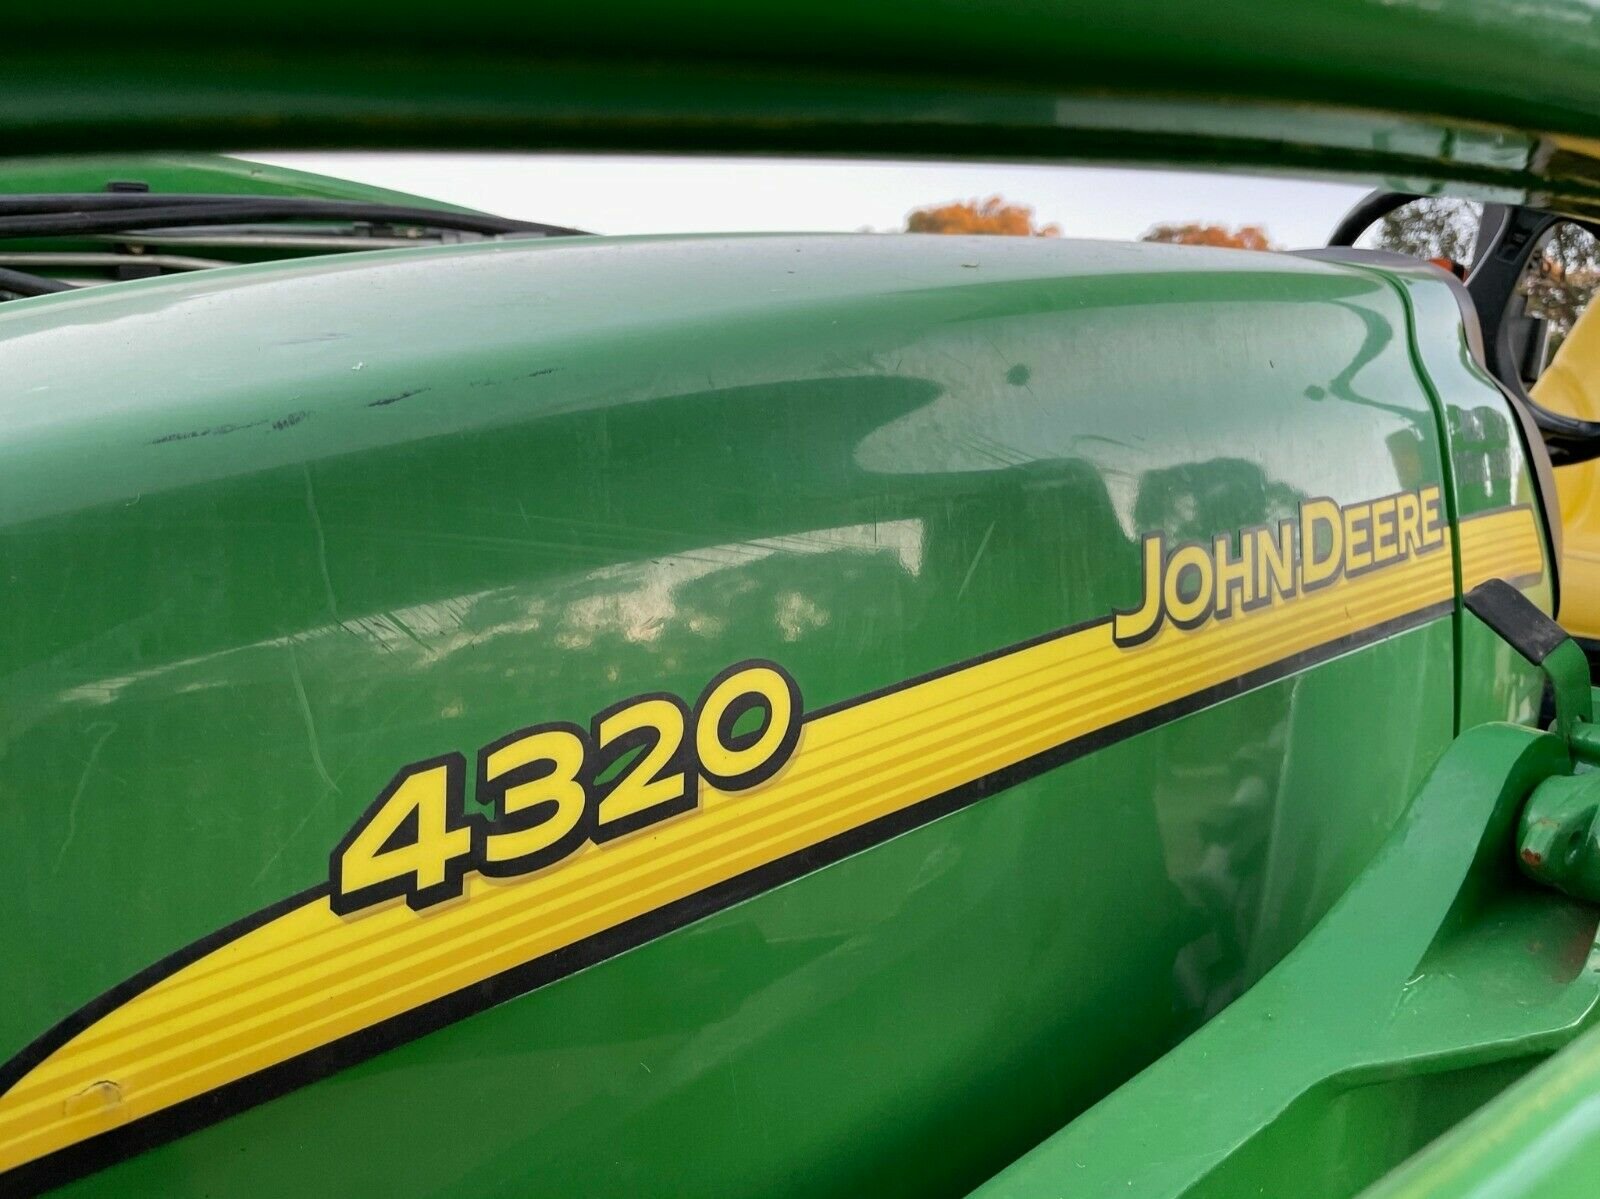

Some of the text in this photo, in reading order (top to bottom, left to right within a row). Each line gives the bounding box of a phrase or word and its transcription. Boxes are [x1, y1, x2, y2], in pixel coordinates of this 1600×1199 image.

[1114, 486, 1442, 642] JOHN DEERE
[336, 663, 797, 905] 4320
